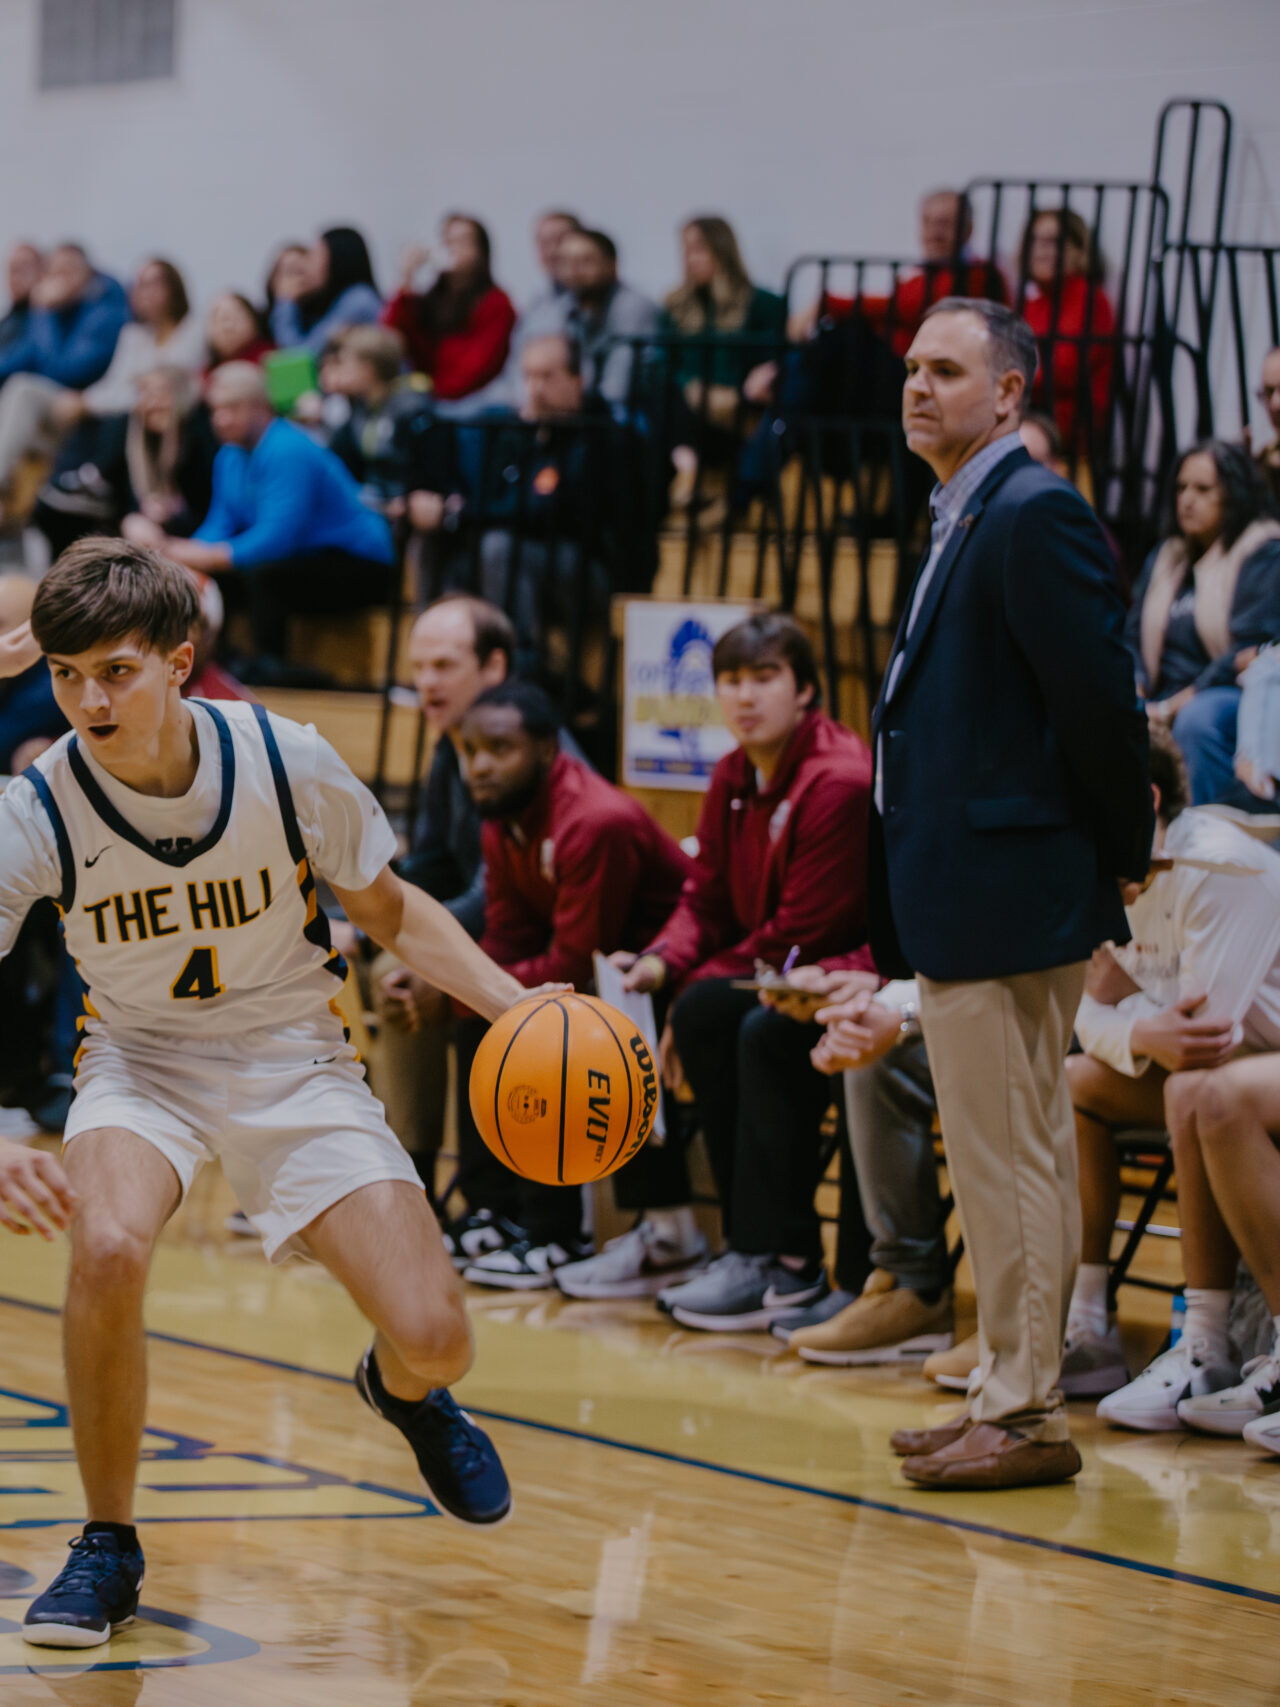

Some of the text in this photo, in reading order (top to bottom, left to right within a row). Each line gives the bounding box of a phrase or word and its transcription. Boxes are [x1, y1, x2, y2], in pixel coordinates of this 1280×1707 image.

[82, 884, 180, 944] THE
[169, 946, 227, 1001] 4
[586, 1067, 612, 1144] EVO
